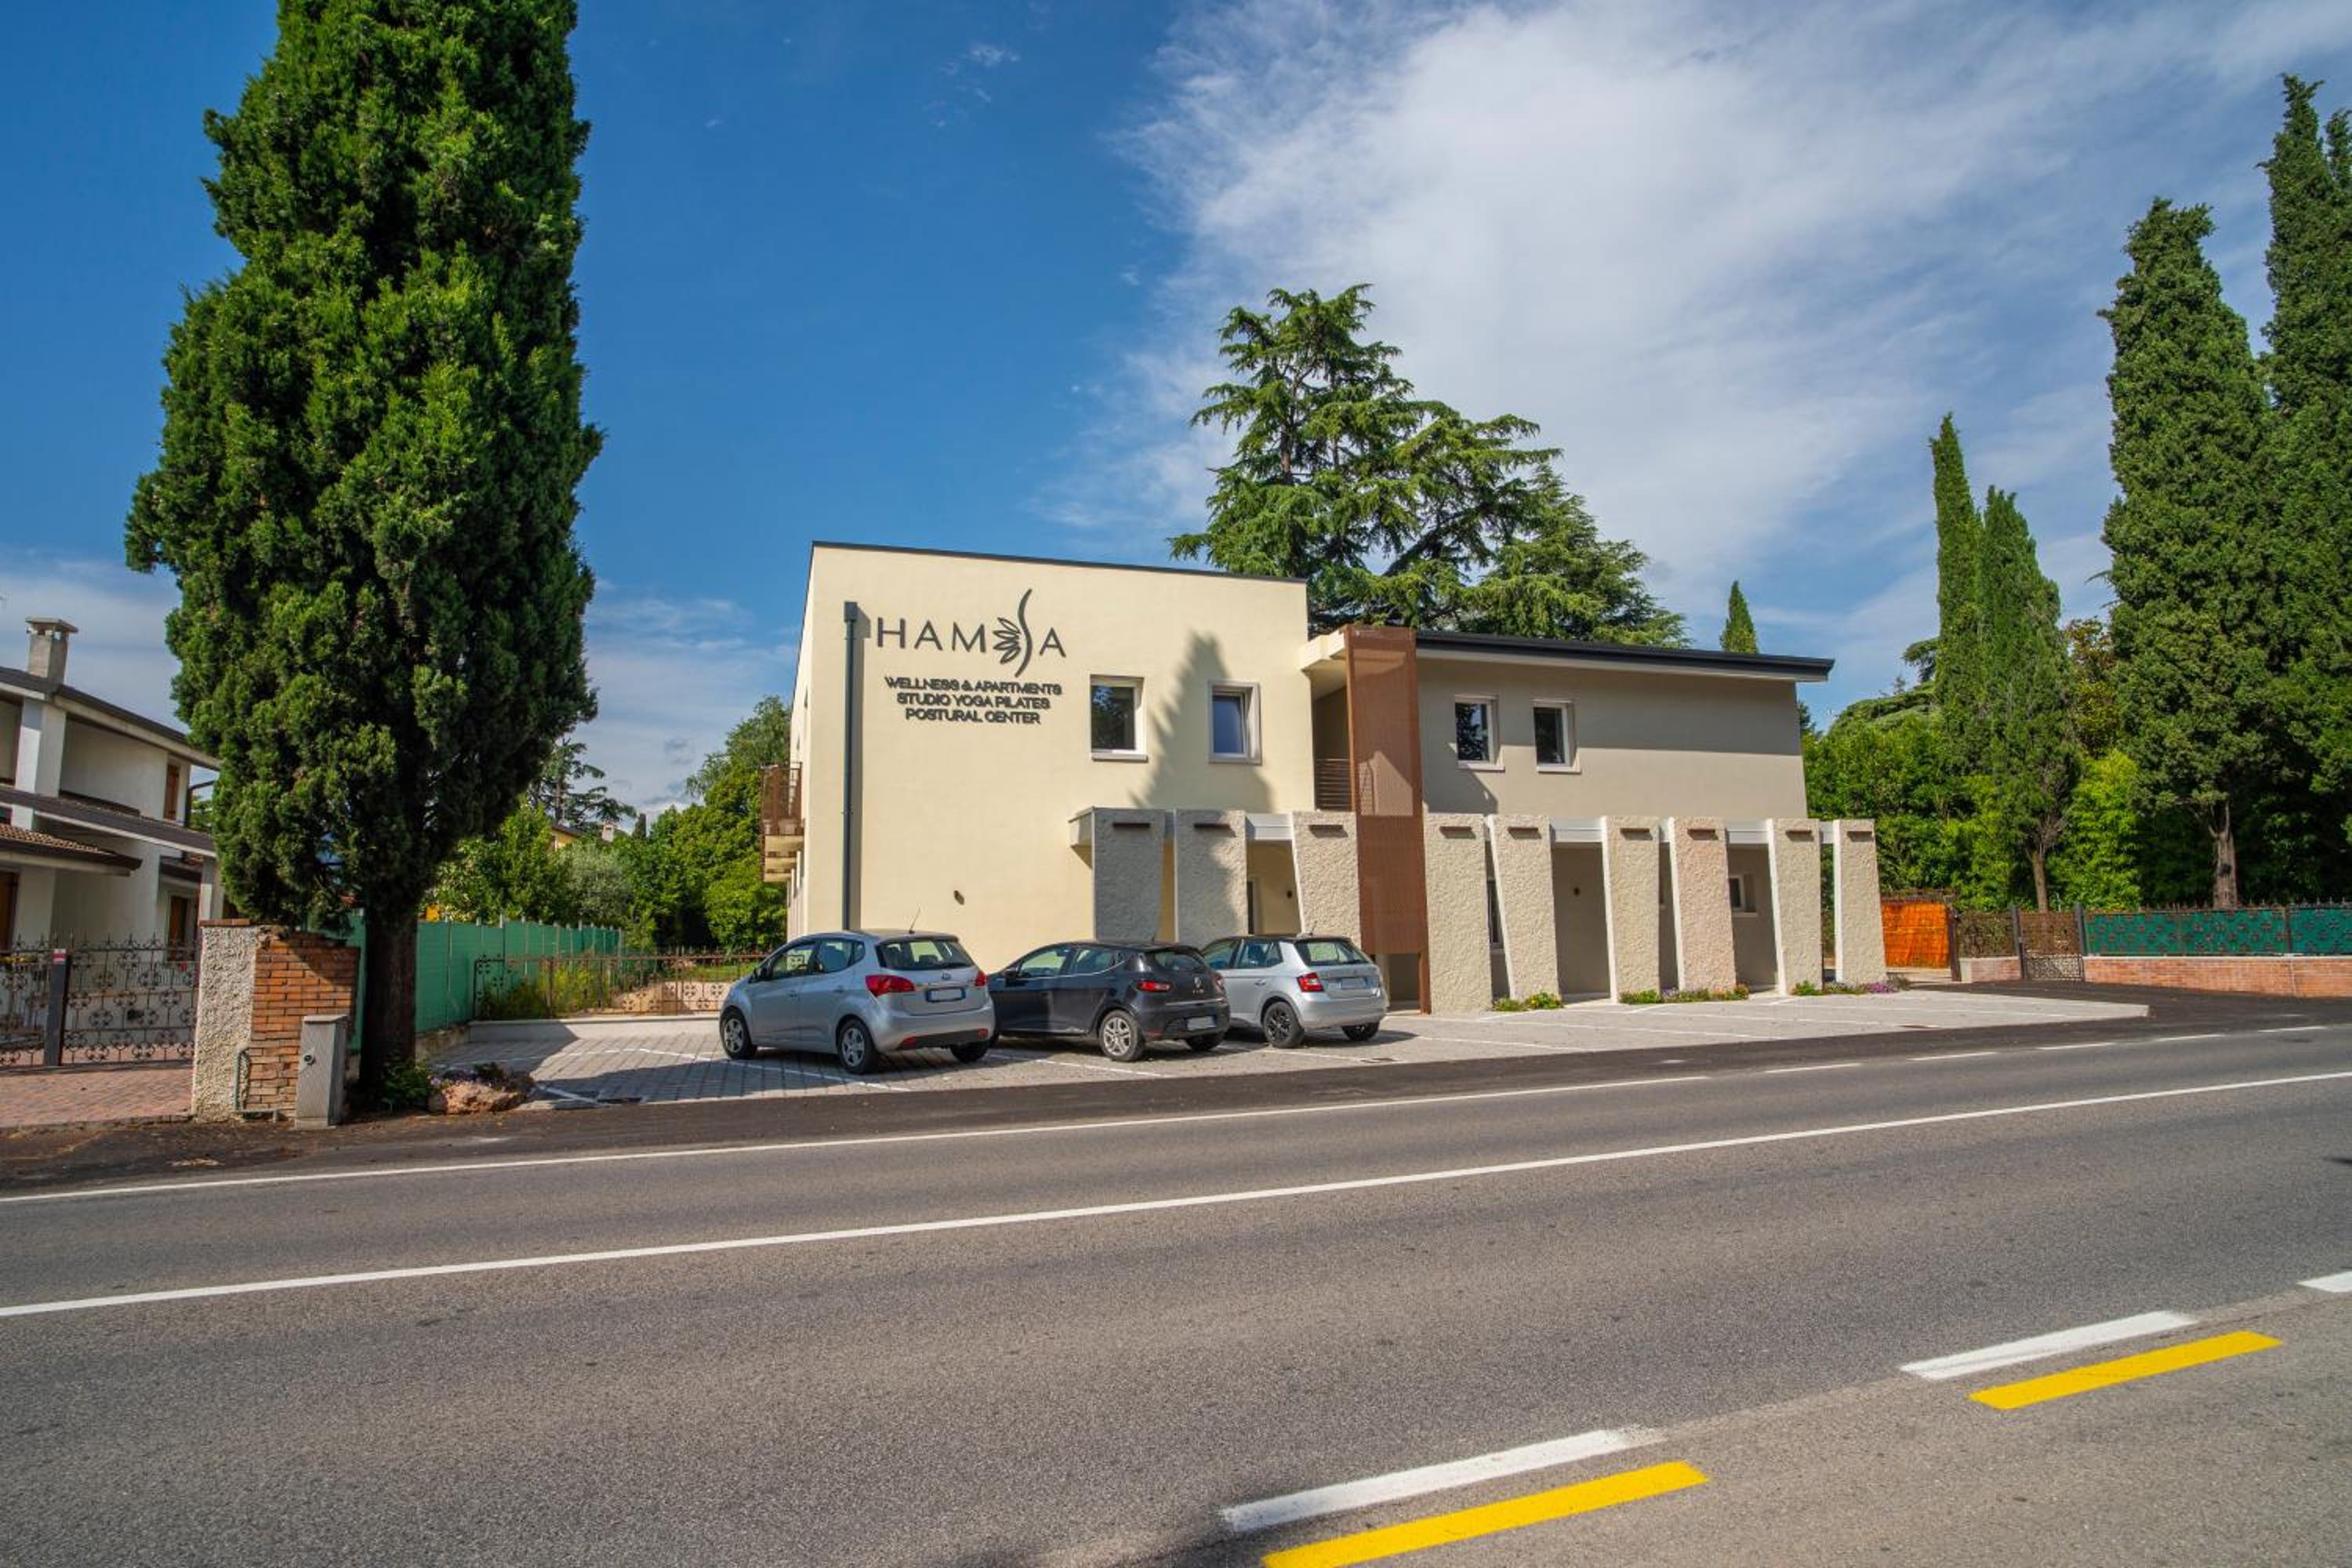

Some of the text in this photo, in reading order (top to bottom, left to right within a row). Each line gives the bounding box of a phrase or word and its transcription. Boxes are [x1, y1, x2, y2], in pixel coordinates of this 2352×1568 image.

[884, 677, 1062, 695] WELLNESS & APARTMENTS
[897, 692, 1050, 709] STUDIO YOGA PILATES
[906, 708, 1040, 724] POSTURAL CENTER
